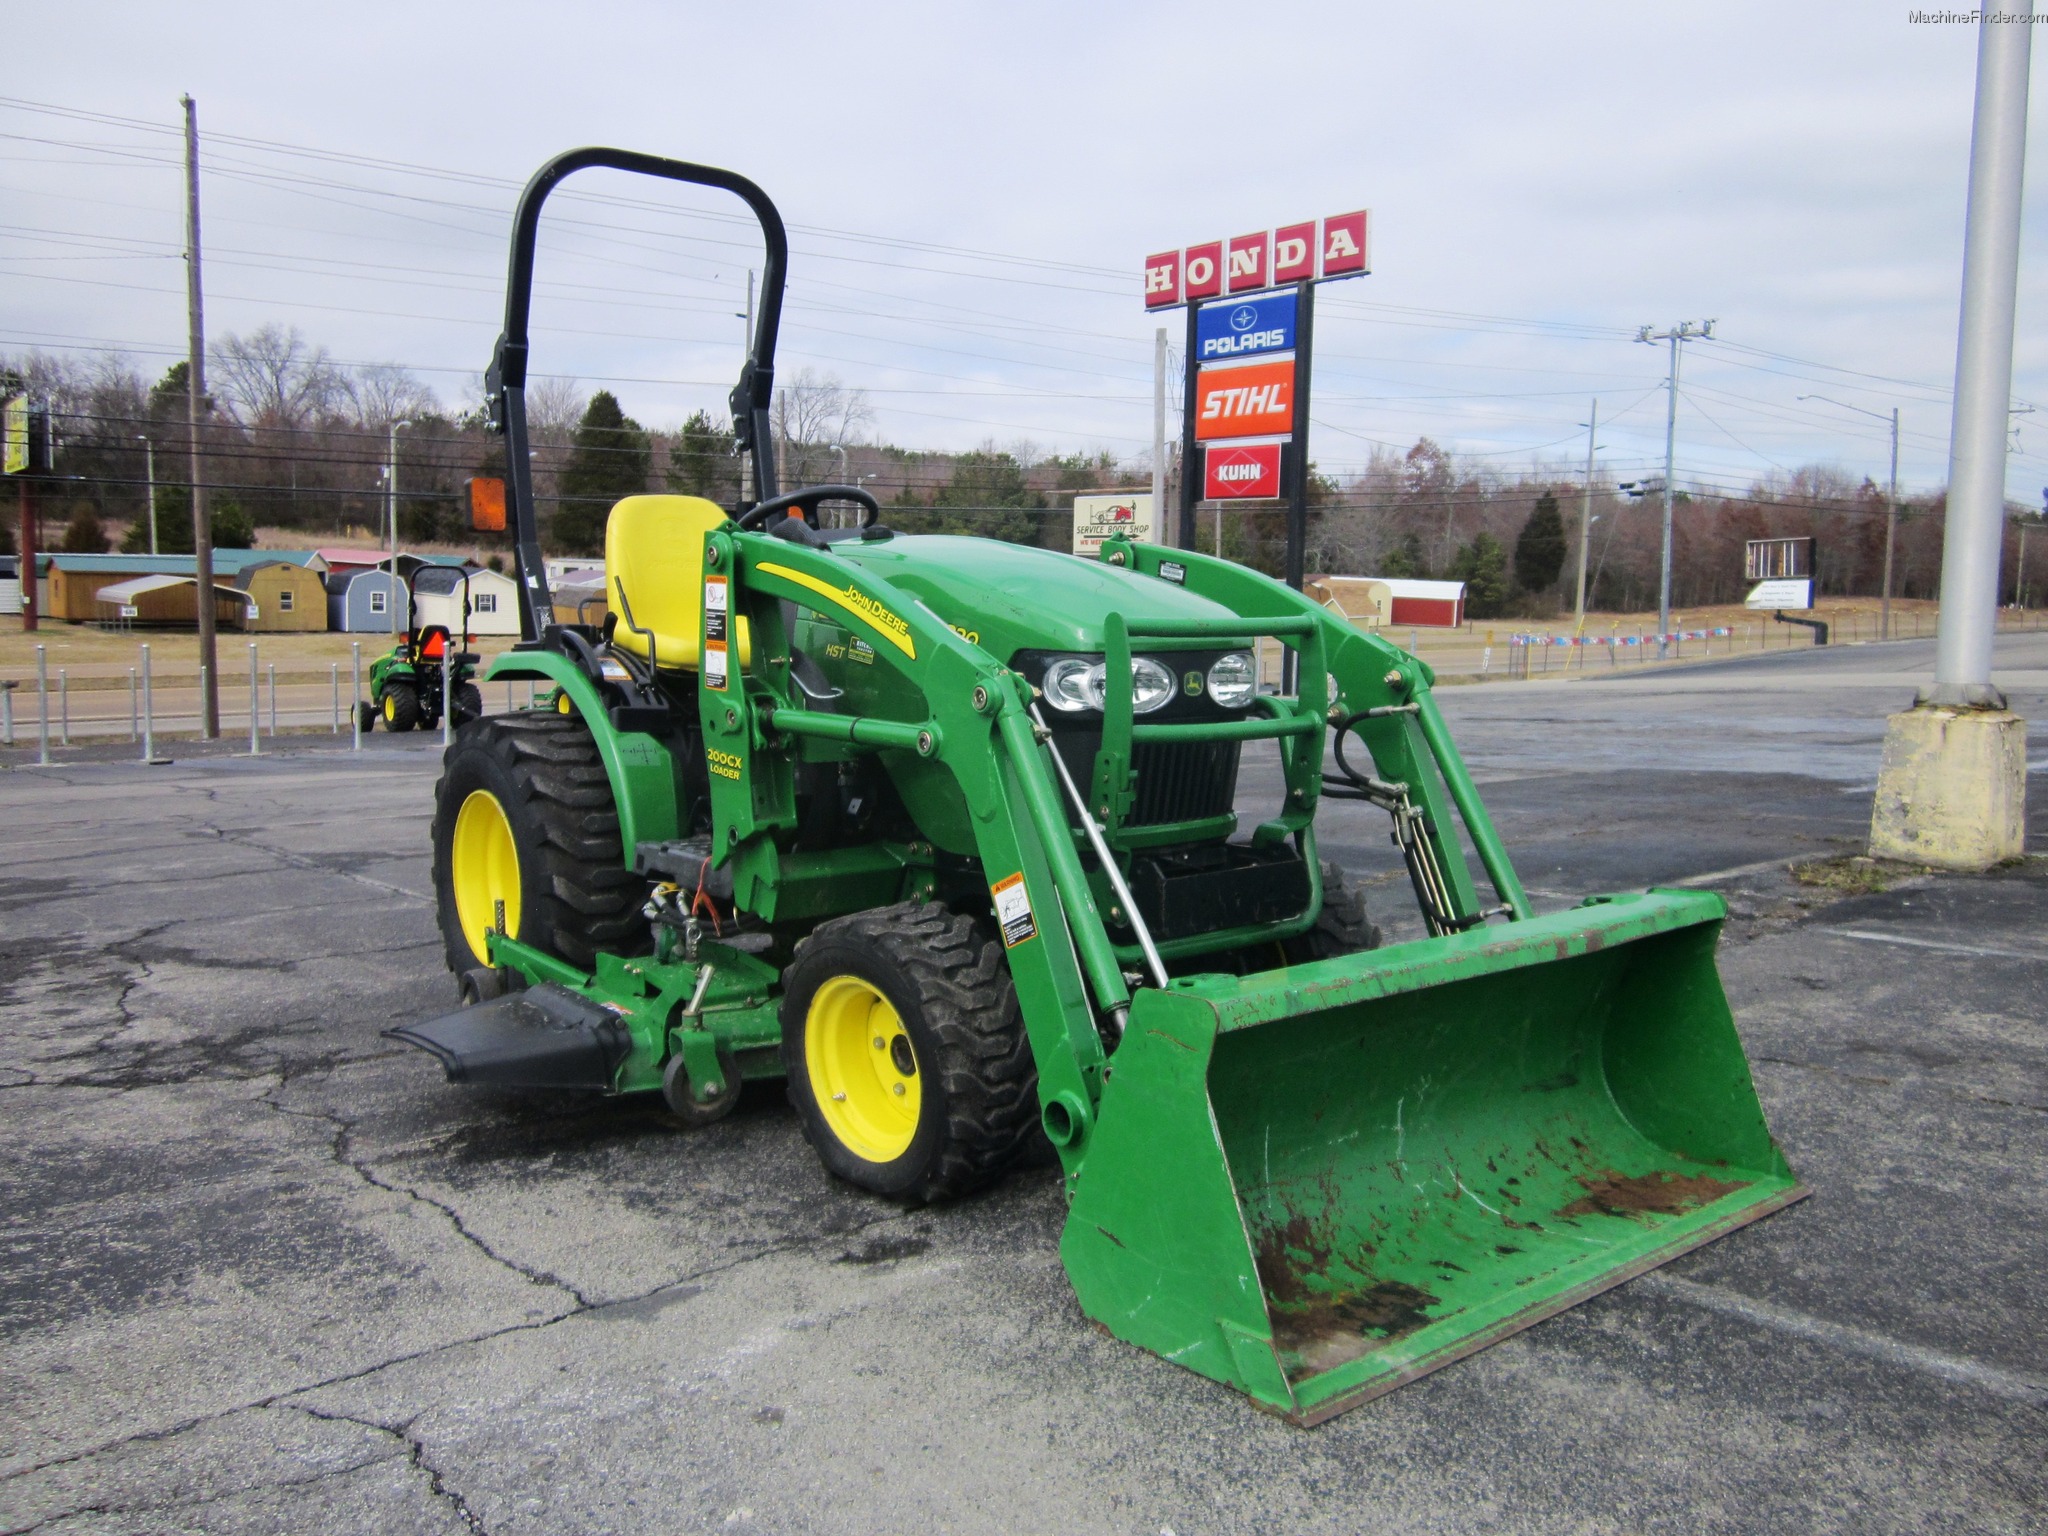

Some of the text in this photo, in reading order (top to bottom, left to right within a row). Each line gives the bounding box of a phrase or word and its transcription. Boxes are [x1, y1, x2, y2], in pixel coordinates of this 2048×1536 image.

[1145, 228, 1359, 293] HONDA
[1204, 328, 1285, 355] POLARIS
[1202, 384, 1286, 419] STIHL
[1218, 463, 1261, 481] KUHN
[1076, 524, 1150, 534] SERVICE BODY SHOP
[843, 585, 909, 635] JOHN DEERE
[825, 644, 846, 659] HST
[707, 748, 742, 769] 200CX
[710, 763, 740, 780] LOADER
